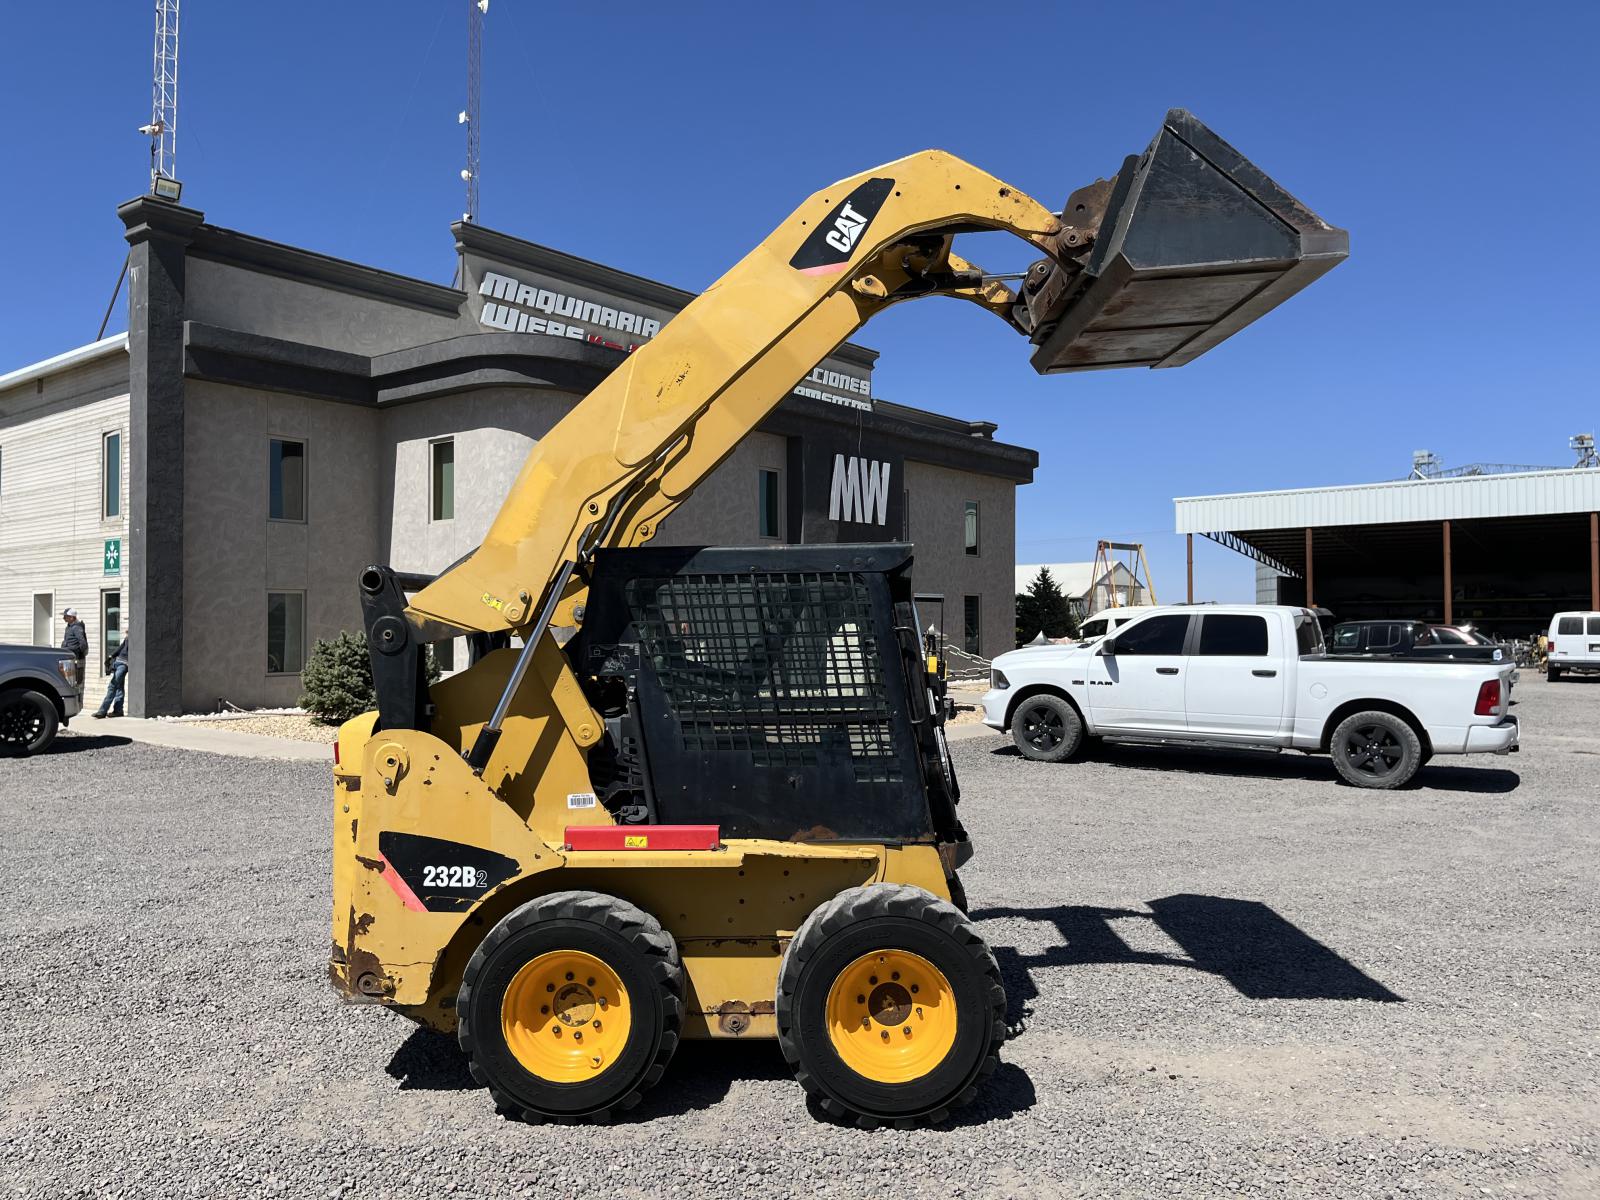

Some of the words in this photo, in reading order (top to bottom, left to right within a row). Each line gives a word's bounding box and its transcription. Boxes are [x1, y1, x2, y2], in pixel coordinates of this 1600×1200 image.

[826, 203, 868, 253] CAT
[479, 271, 661, 338] MAQUINARIA
[805, 367, 871, 396] CIONES
[829, 454, 891, 526] MW
[423, 865, 488, 888] 232B2
